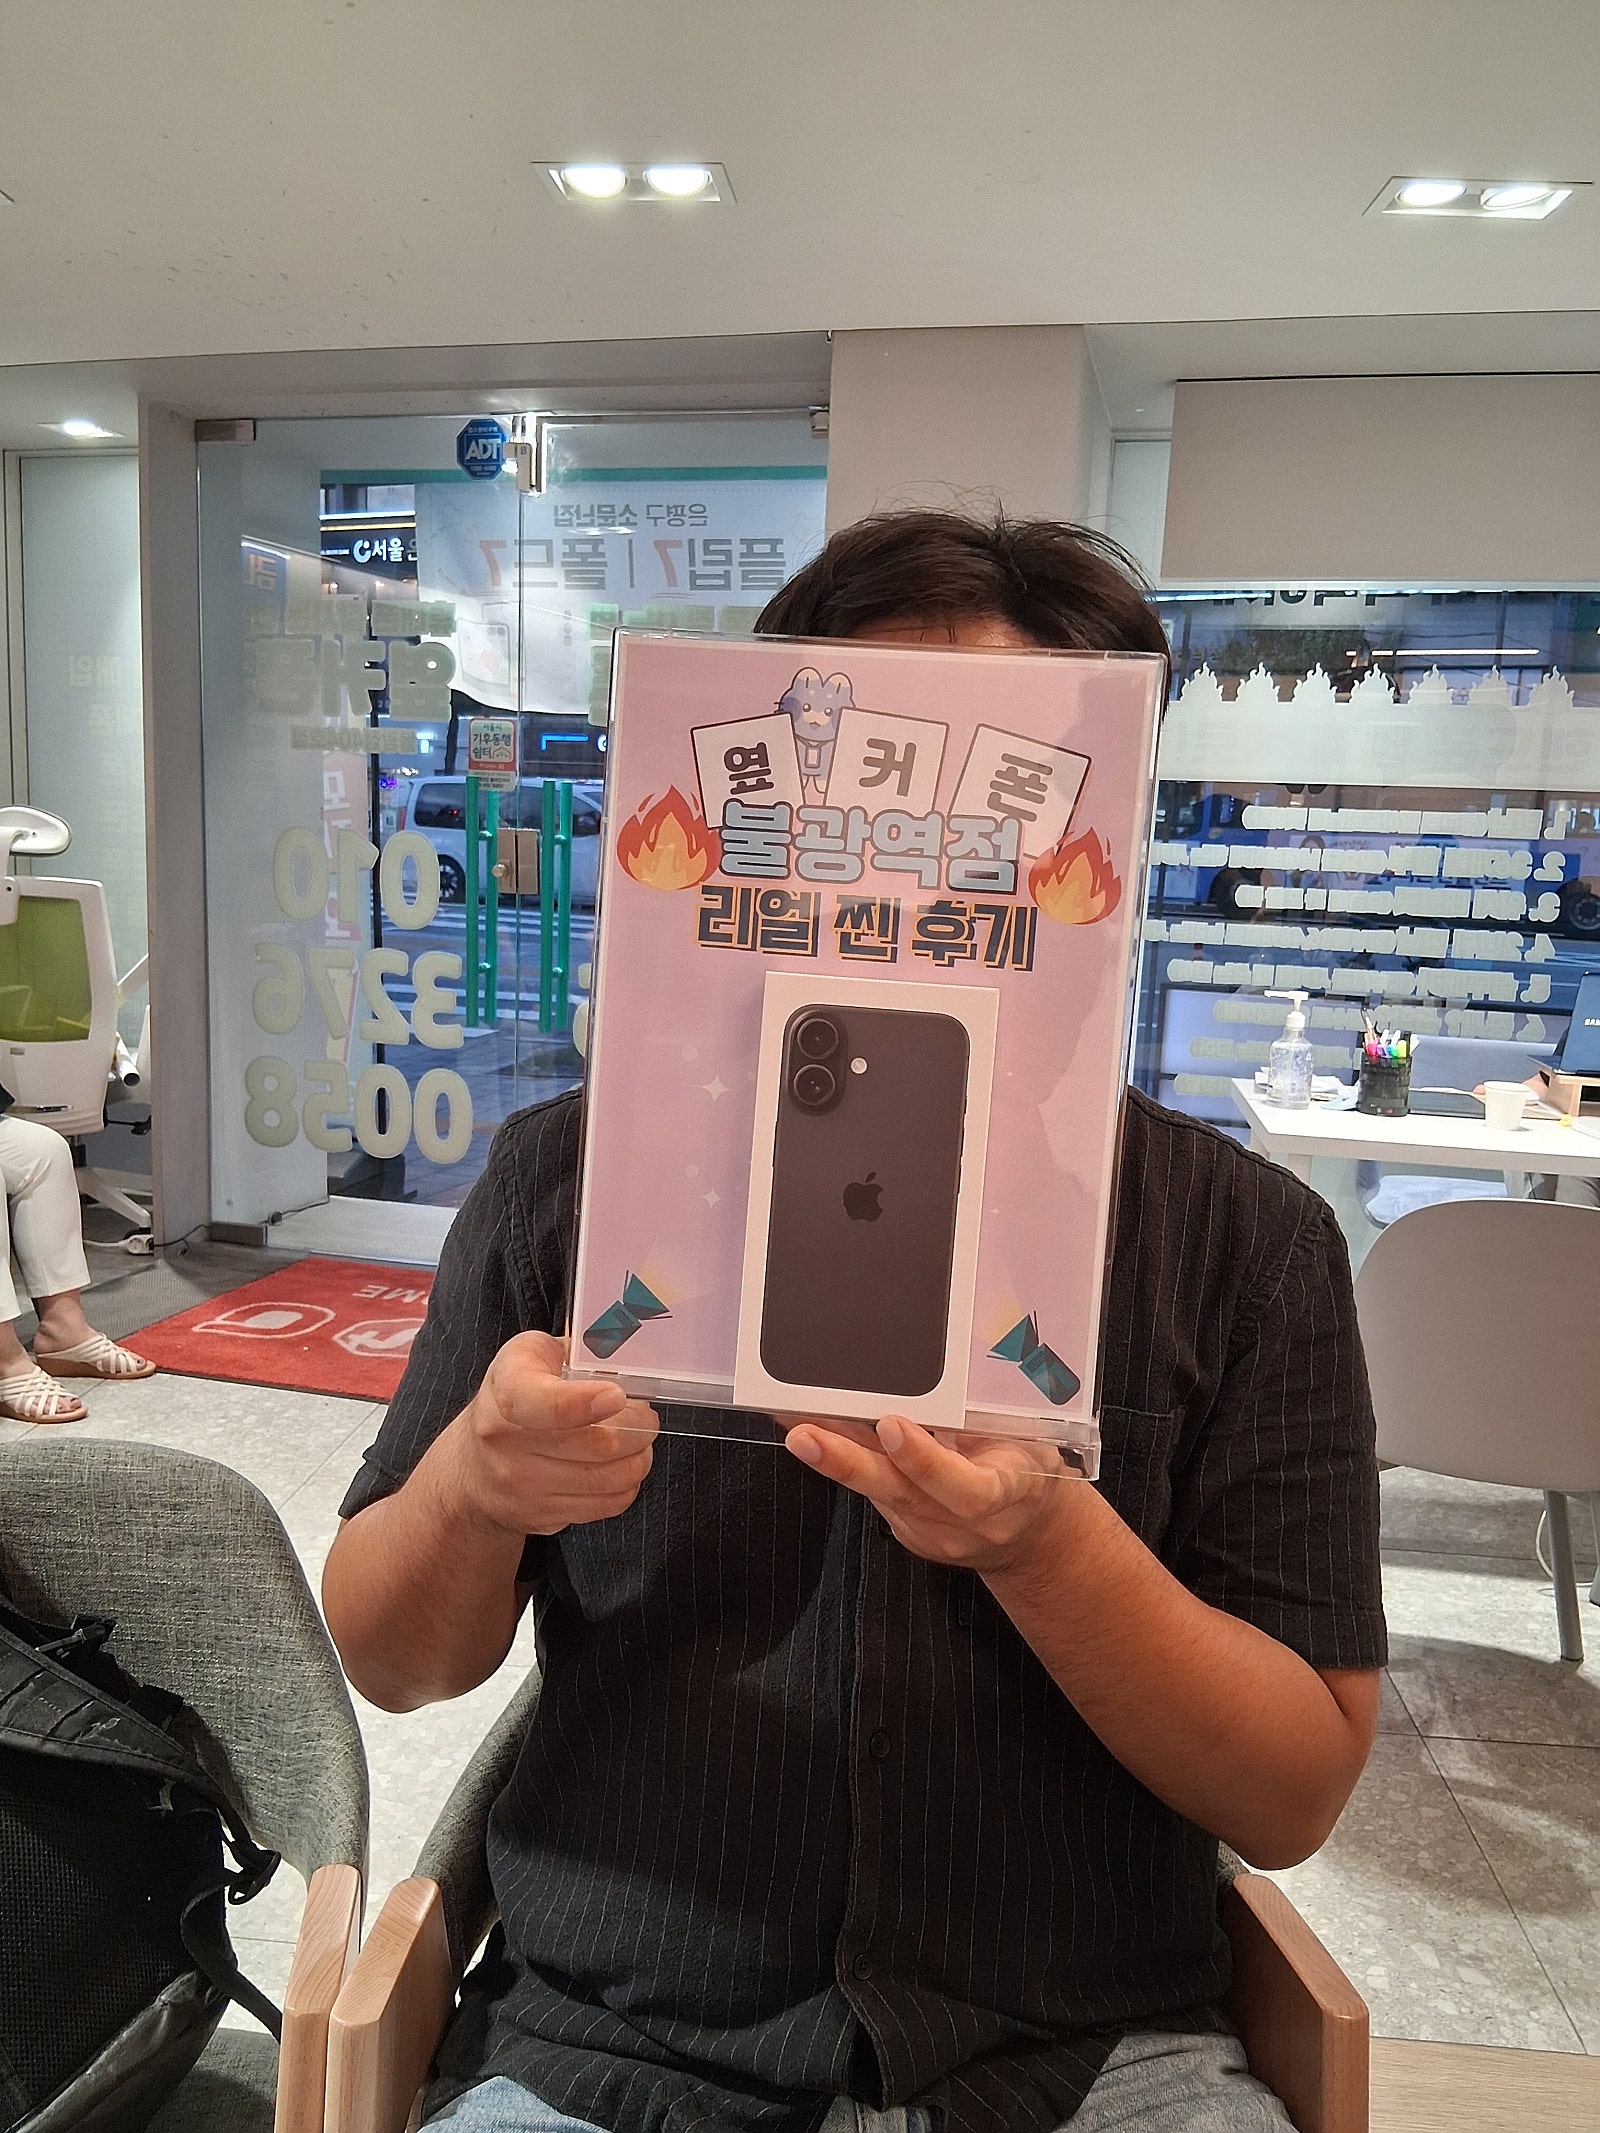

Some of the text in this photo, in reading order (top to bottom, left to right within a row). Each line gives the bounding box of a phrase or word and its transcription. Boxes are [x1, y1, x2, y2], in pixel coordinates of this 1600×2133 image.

[465, 438, 501, 460] ADT
[719, 798, 1019, 896] 불광역점
[698, 884, 1038, 972] 리얼 찐 후기
